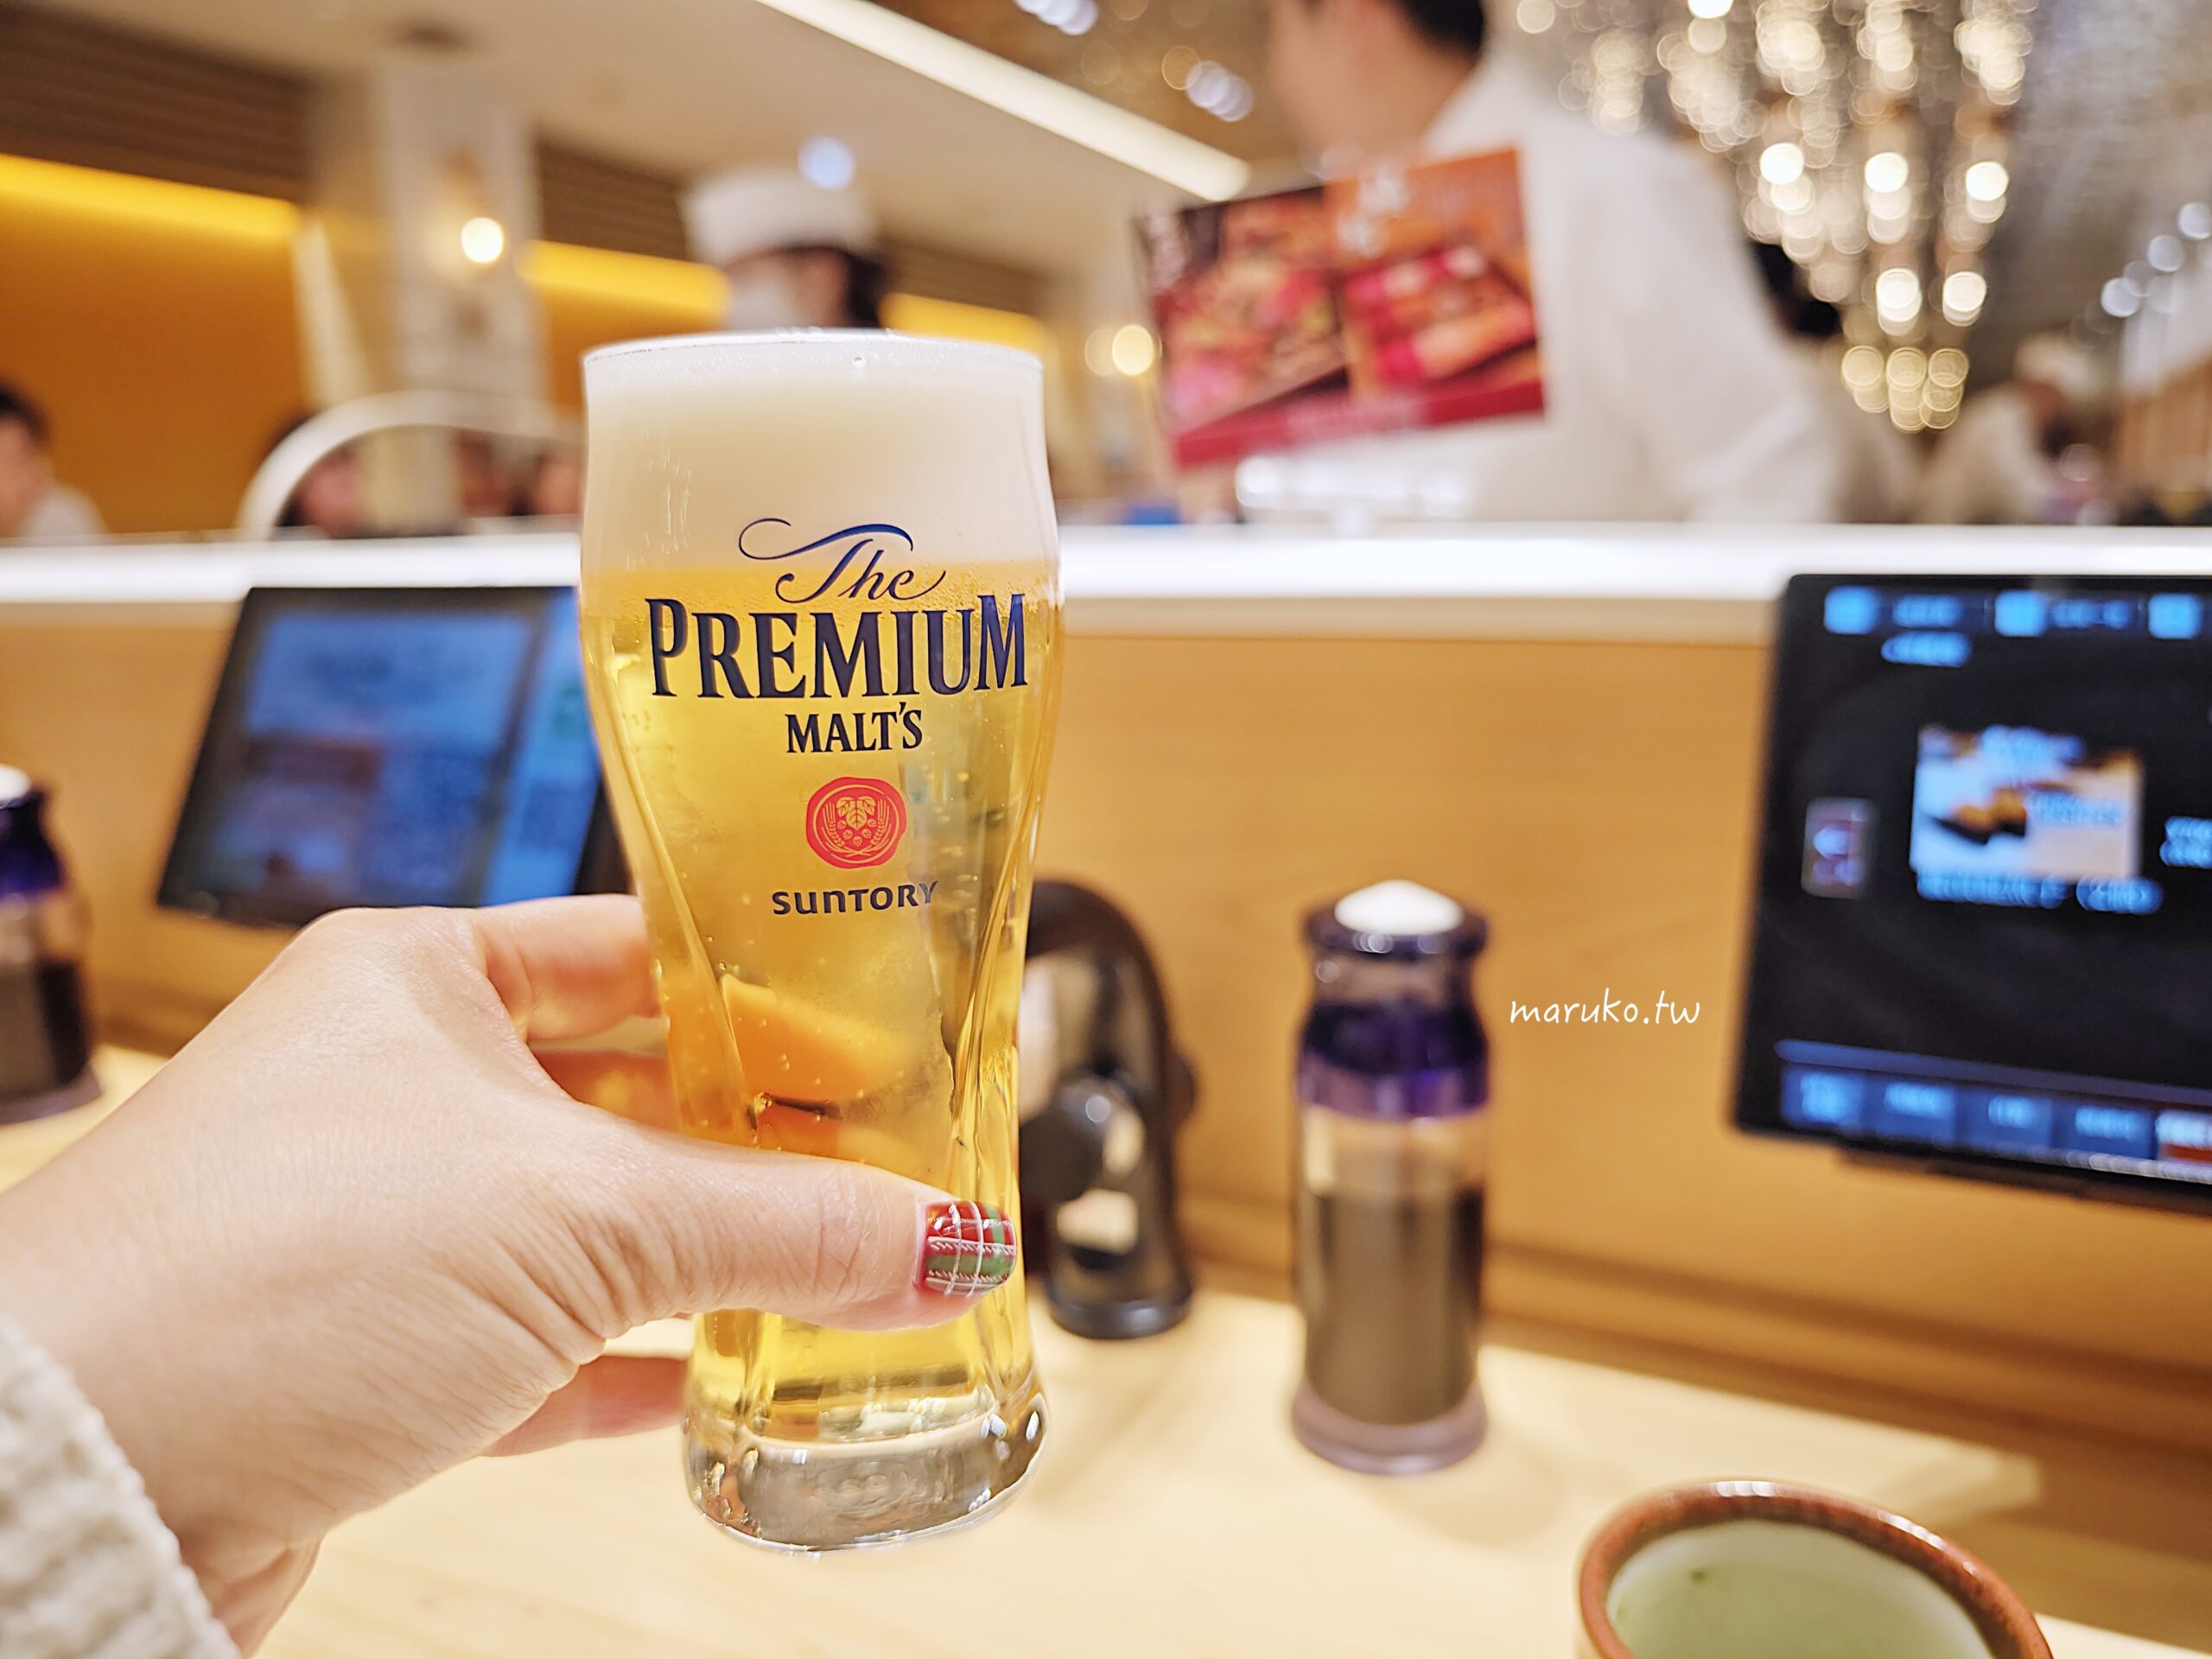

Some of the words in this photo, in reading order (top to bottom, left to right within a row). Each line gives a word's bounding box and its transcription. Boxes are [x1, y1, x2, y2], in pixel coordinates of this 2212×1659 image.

[739, 518, 946, 602] The
[645, 593, 1028, 698] PREMIUM
[785, 702, 924, 753] MALT'S
[772, 880, 938, 916] SUNTORY
